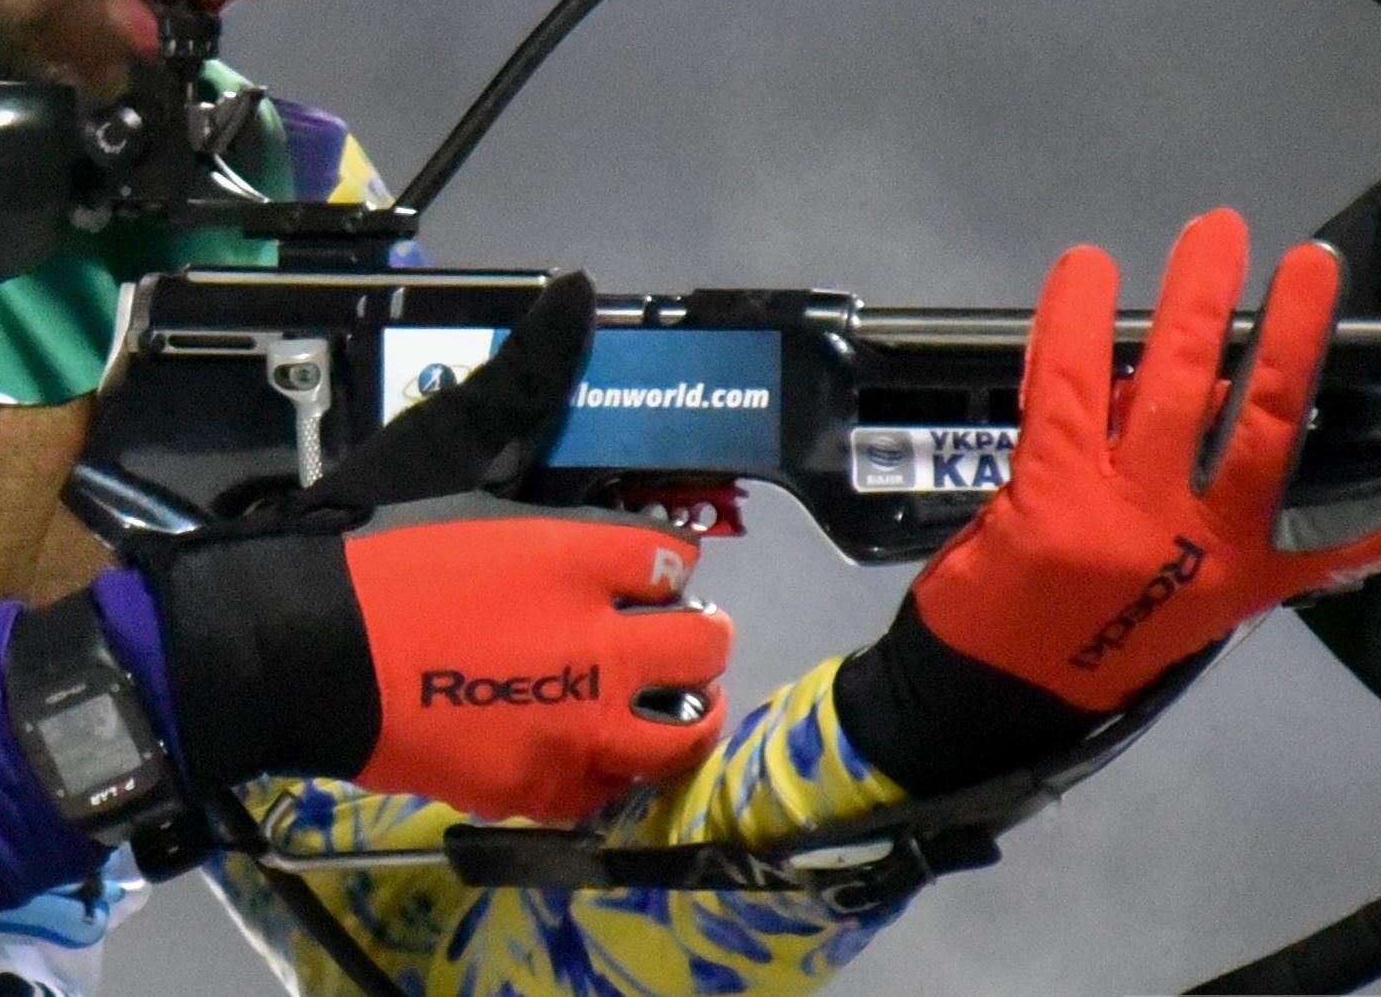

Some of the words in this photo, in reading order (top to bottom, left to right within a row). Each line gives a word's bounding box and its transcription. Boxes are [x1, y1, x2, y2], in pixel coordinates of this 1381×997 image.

[572, 381, 770, 408] lonworld.com
[930, 430, 1019, 451] УКРА
[420, 664, 600, 708] Roeckl
